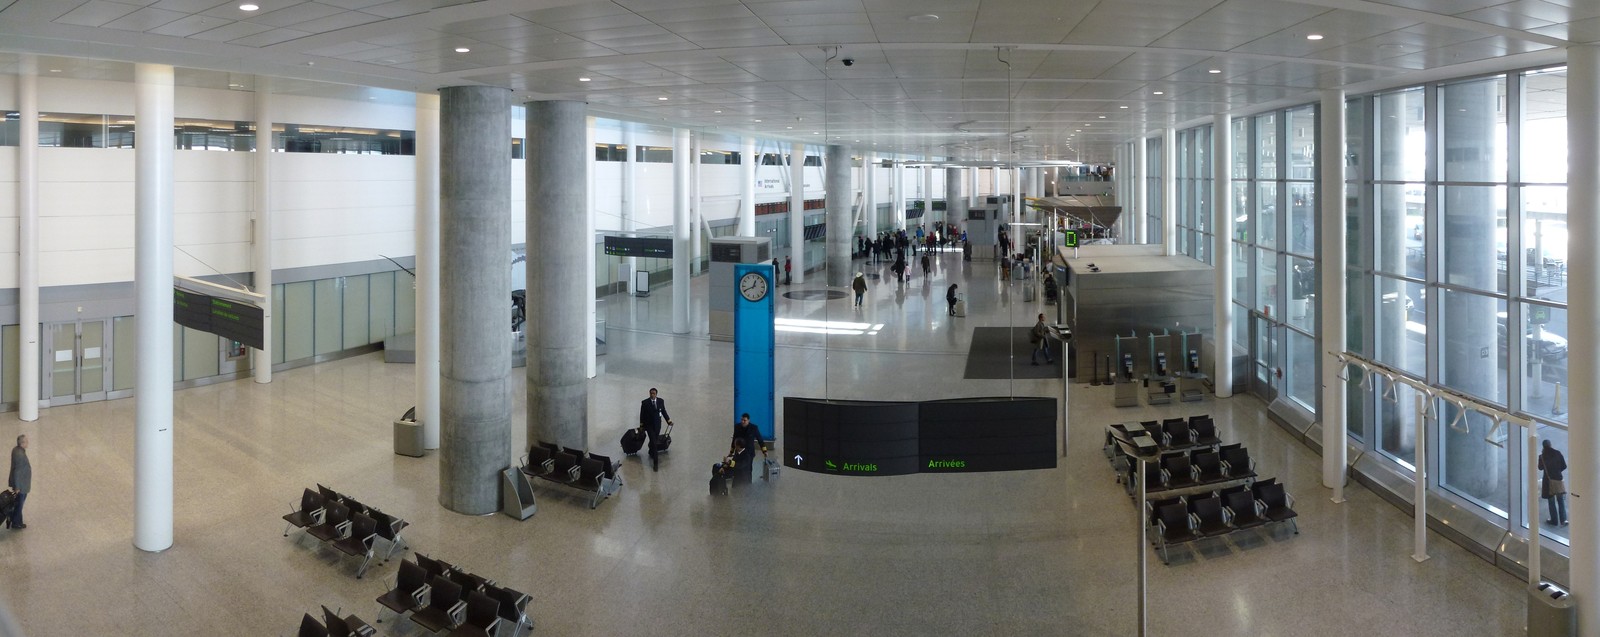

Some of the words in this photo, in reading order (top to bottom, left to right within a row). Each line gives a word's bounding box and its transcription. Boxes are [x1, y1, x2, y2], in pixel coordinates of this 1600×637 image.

[1066, 231, 1076, 246] D
[842, 463, 878, 472] Arrivals
[928, 459, 966, 468] Arrivées
